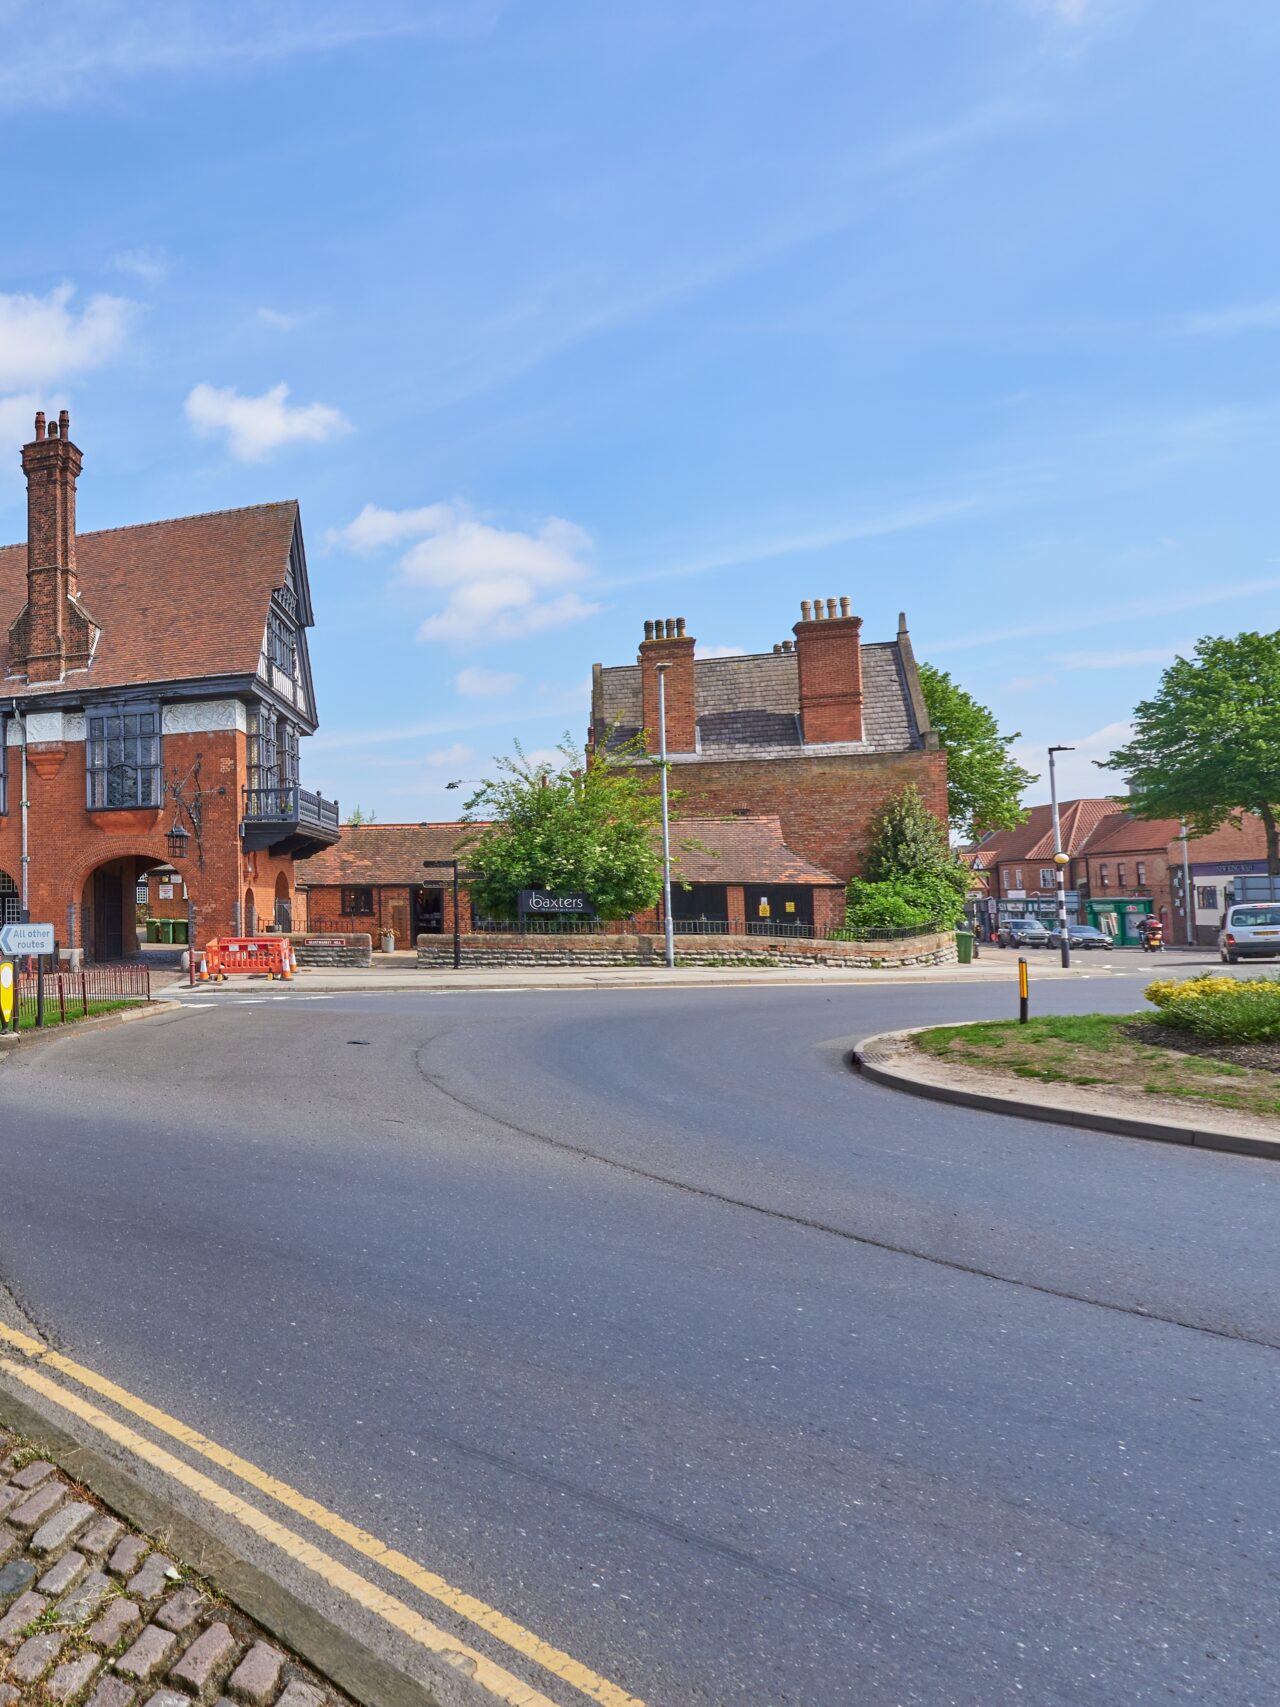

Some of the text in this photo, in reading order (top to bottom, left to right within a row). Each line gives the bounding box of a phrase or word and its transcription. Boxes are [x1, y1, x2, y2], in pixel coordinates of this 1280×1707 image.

[529, 891, 583, 910] baxters
[13, 929, 50, 938] All other
[17, 940, 45, 949] routes
